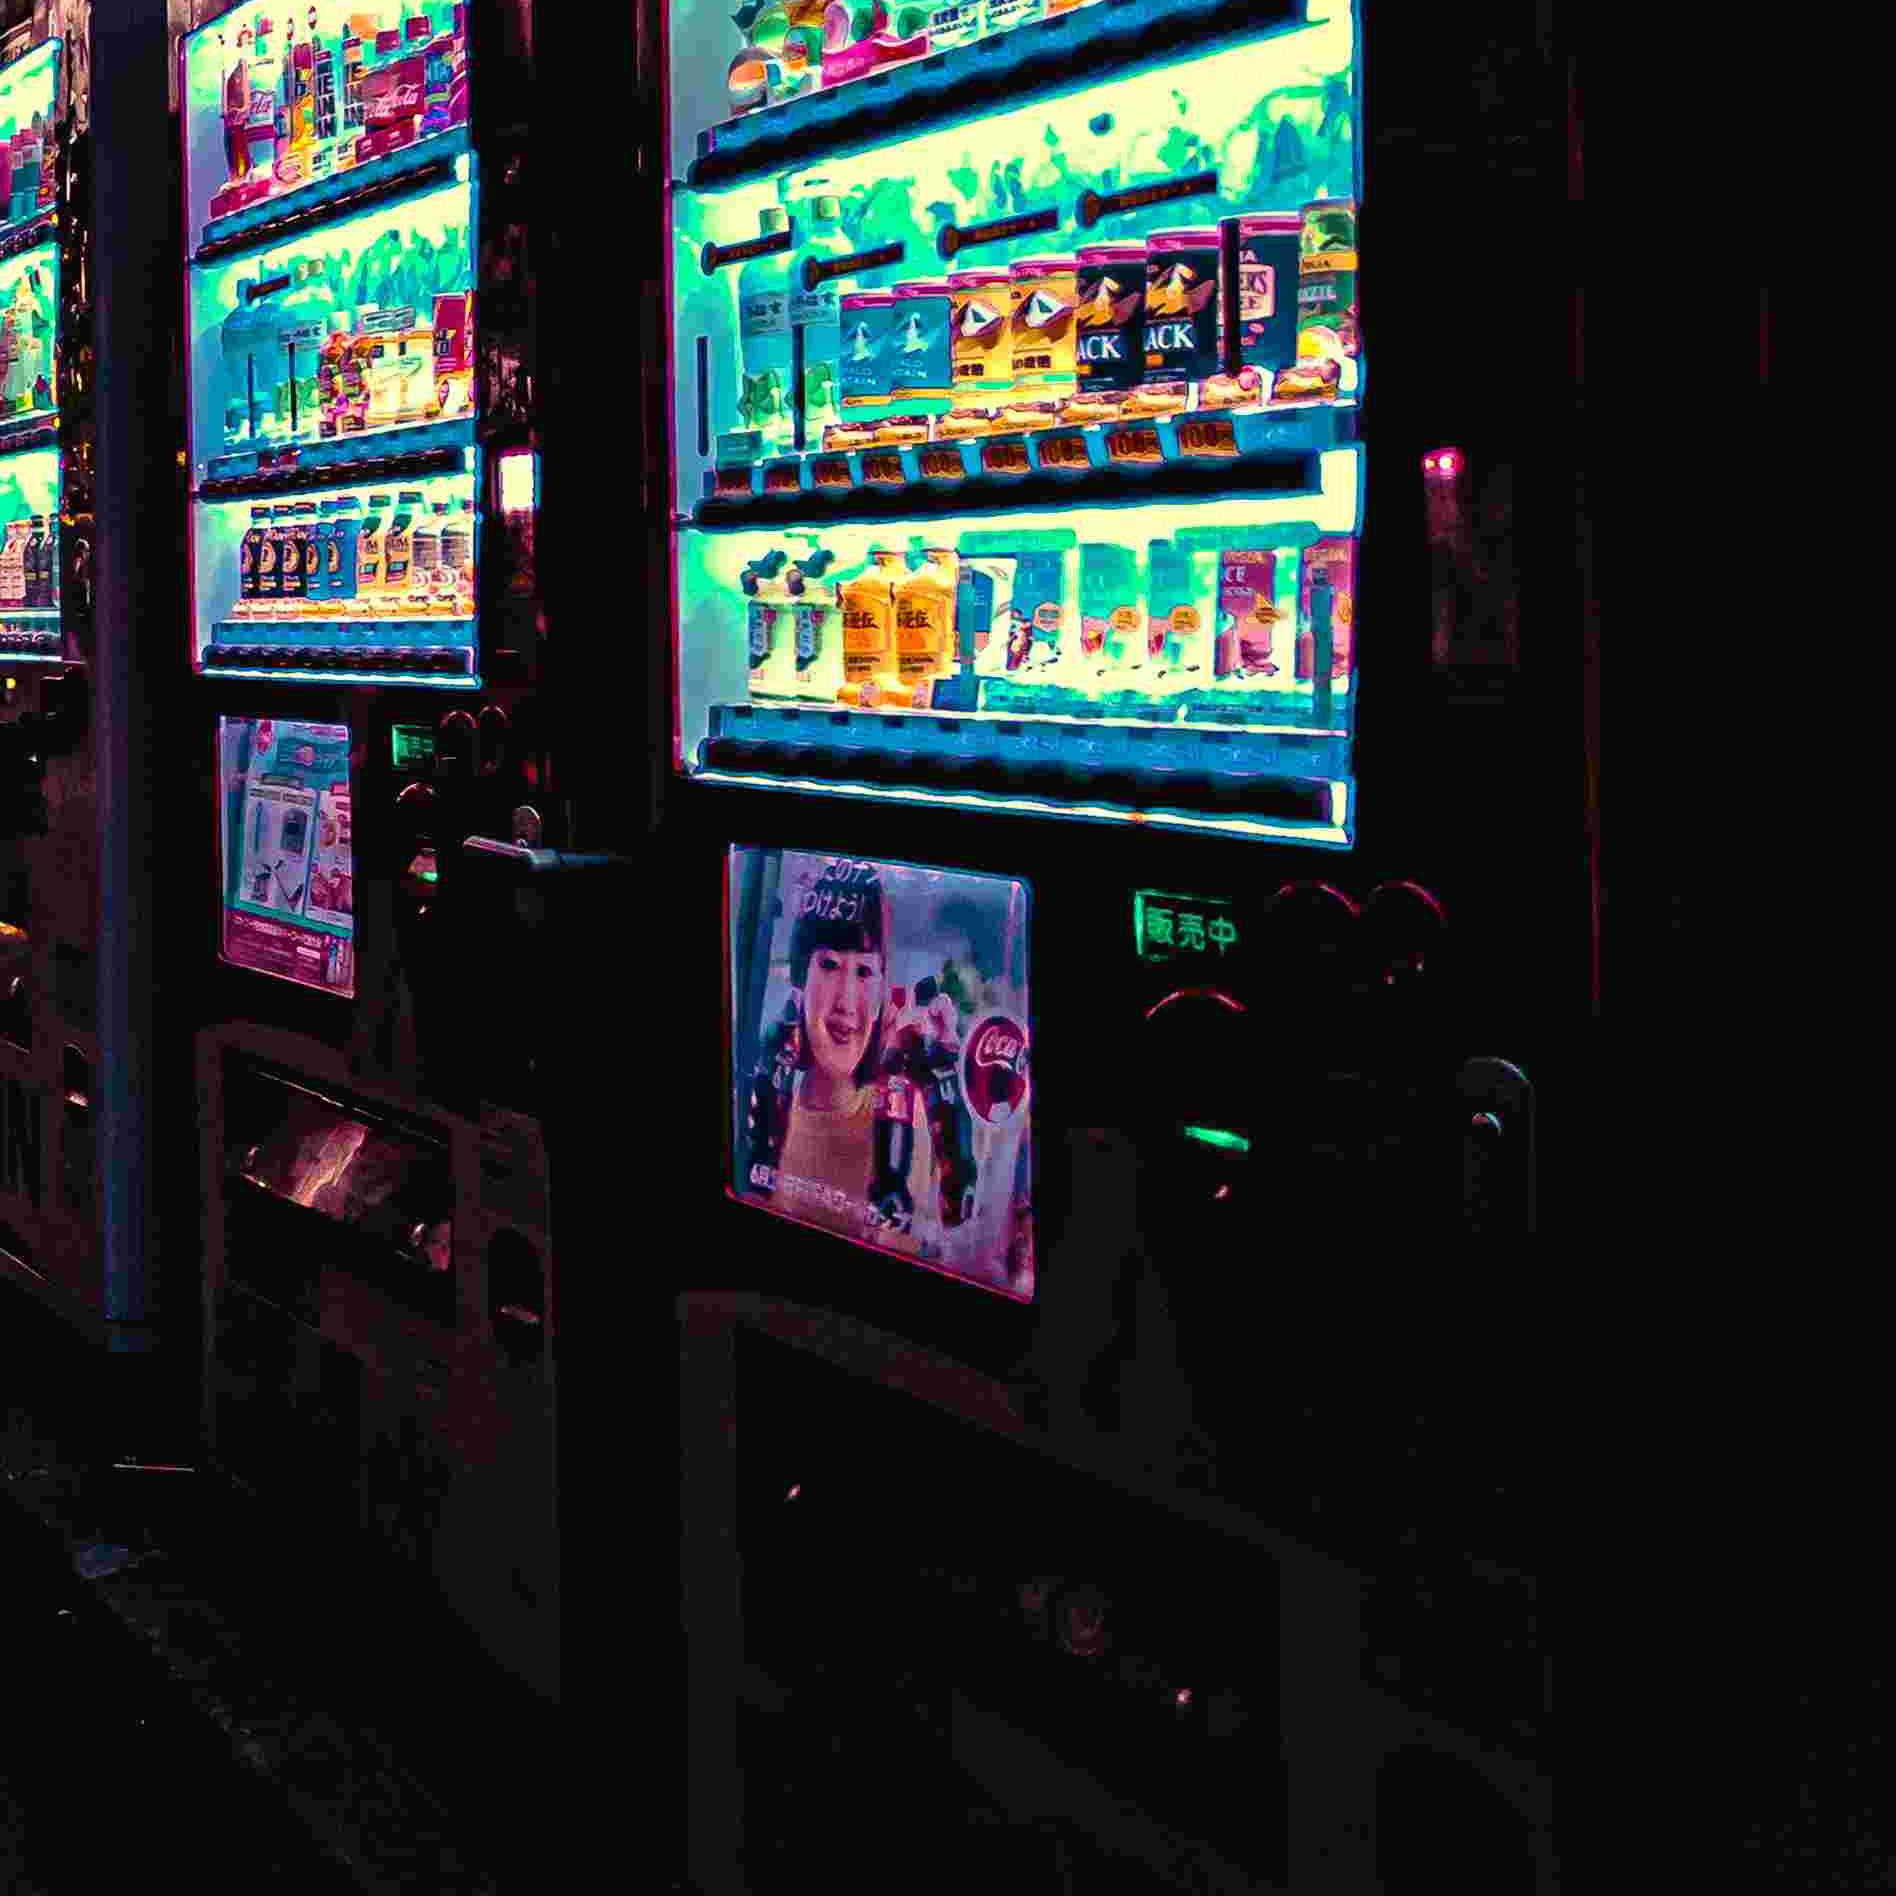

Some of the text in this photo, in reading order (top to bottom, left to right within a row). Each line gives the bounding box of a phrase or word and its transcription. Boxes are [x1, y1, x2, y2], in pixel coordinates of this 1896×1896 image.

[1078, 335, 1121, 361] ACK
[1144, 324, 1195, 351] ACK
[1145, 907, 1239, 957] 販売中
